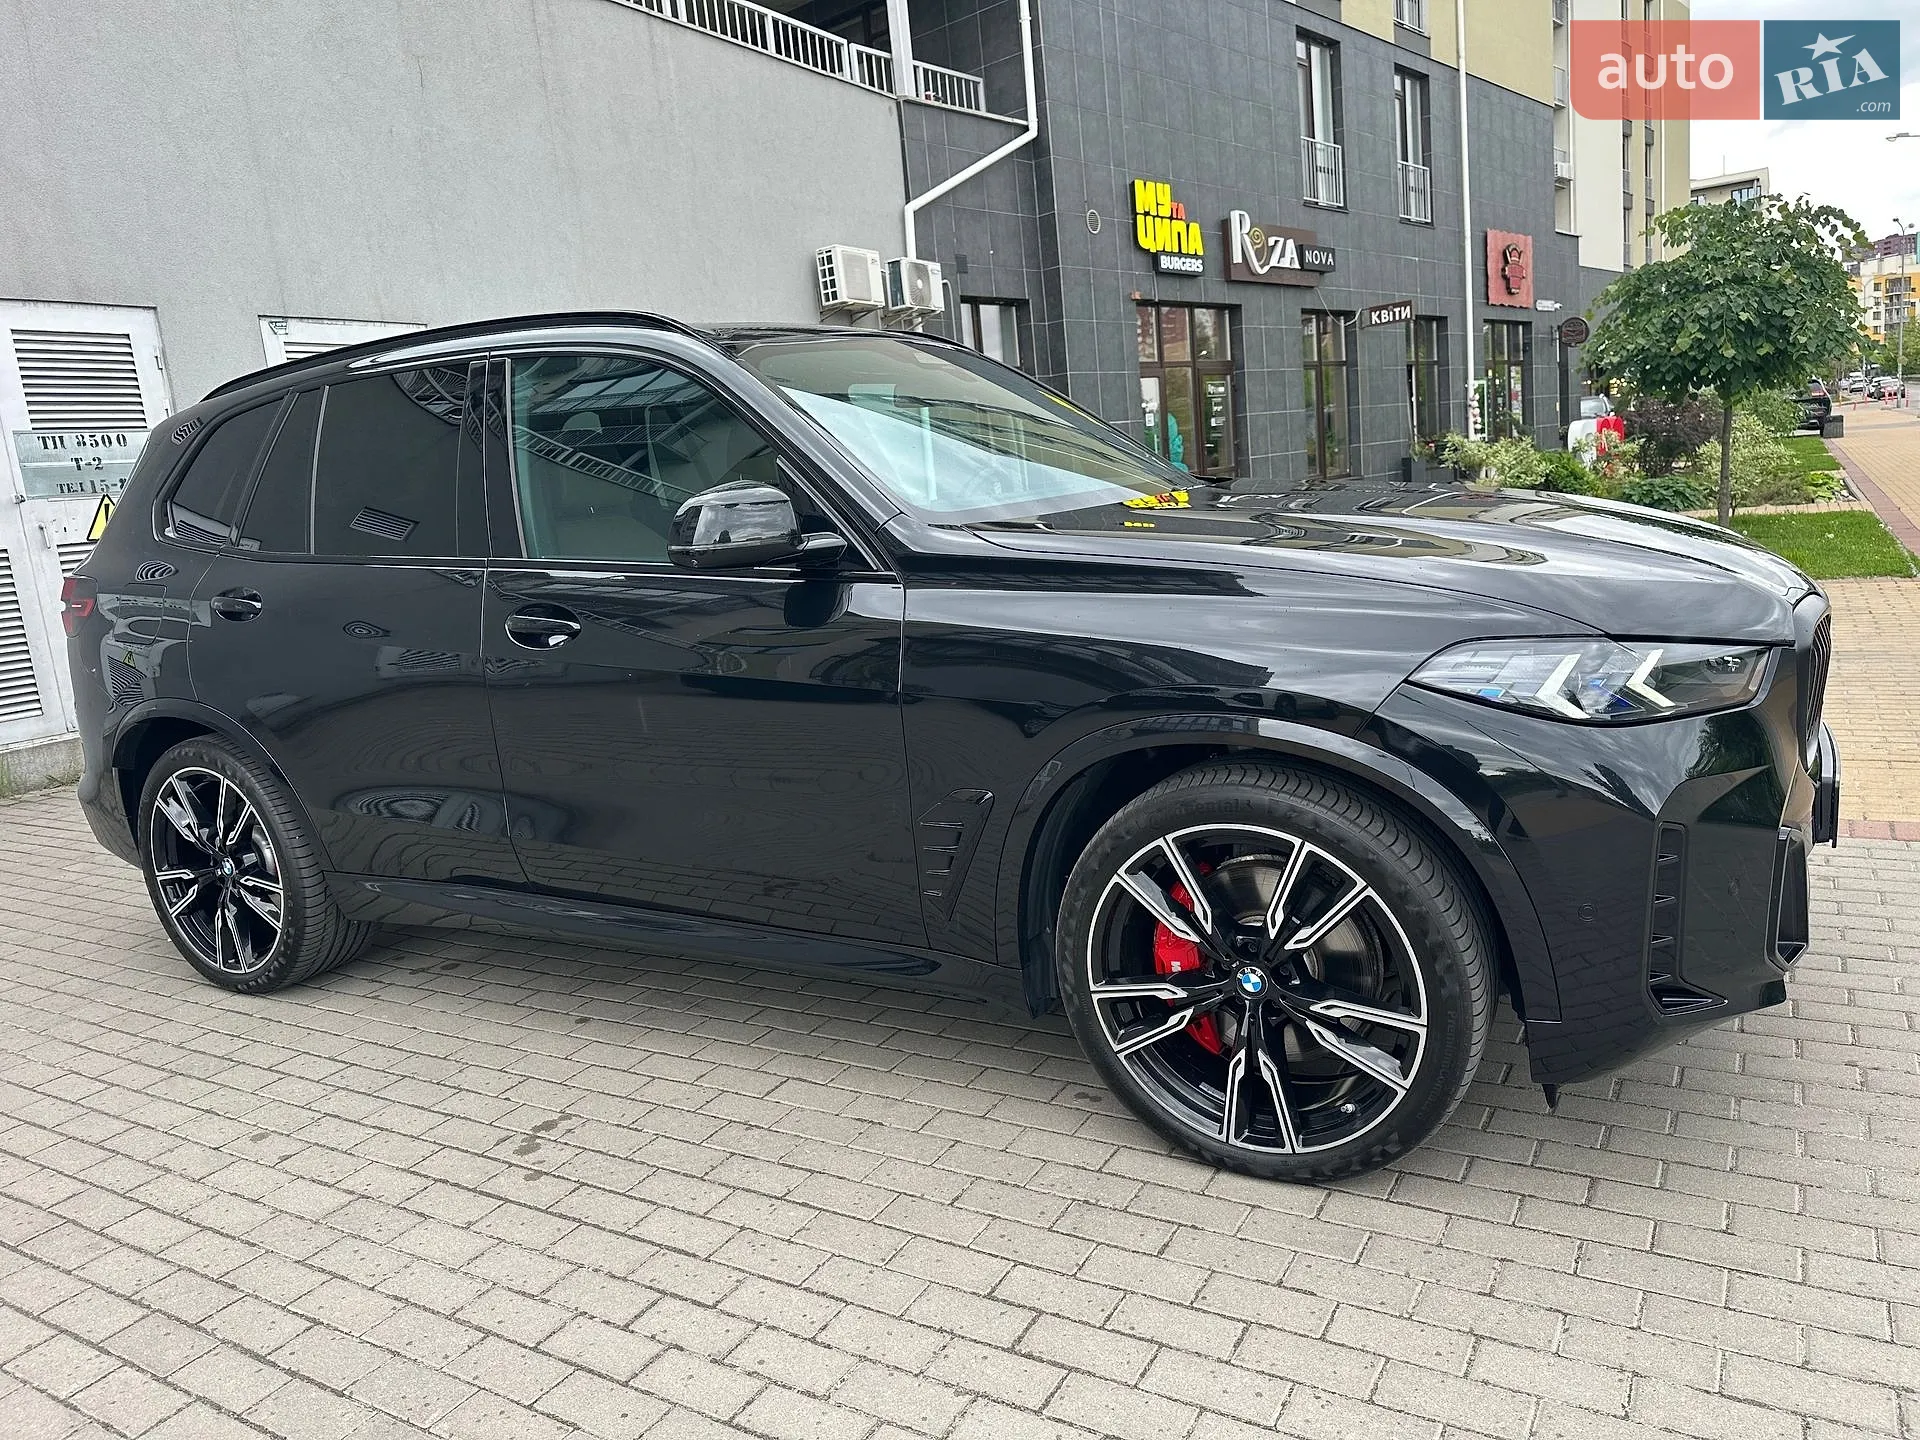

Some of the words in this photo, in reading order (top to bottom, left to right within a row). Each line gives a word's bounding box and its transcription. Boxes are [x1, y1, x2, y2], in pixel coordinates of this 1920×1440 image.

[1134, 179, 1171, 217] МУ
[1136, 214, 1204, 256] ЦИПА
[1160, 255, 1204, 273] BURGERS
[1305, 250, 1335, 266] NOVA
[75, 433, 128, 449] 8500
